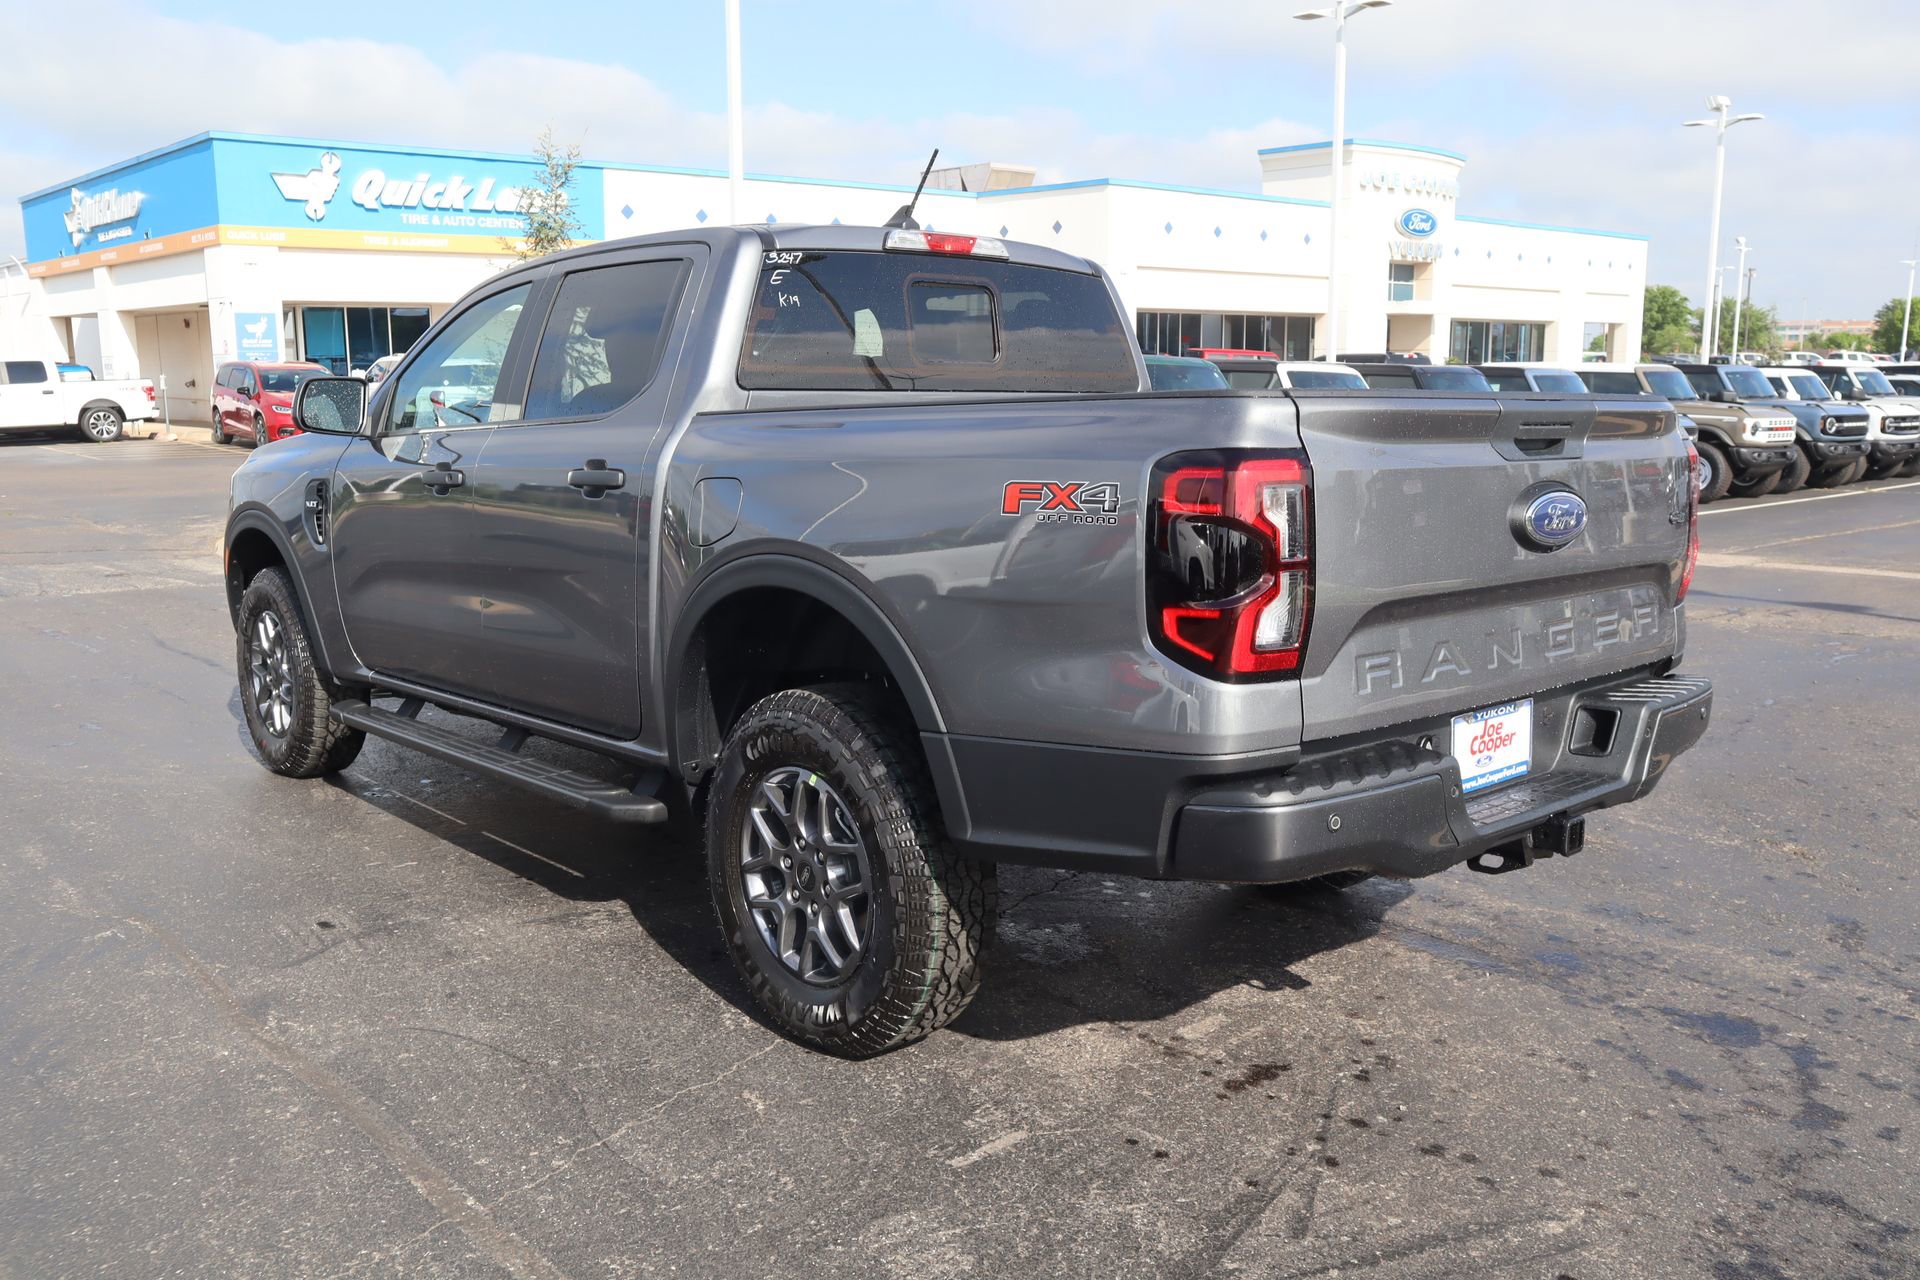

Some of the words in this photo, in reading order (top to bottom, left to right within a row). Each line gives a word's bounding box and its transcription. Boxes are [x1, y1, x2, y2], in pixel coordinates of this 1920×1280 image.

[351, 169, 474, 212] Quick
[400, 213, 430, 225] TIRE
[432, 215, 441, 225] &
[443, 216, 476, 227] AUTO
[770, 269, 791, 285] E
[1001, 480, 1121, 516] FX4
[1036, 513, 1069, 524] OFF
[1073, 515, 1120, 526] ROAD
[1353, 602, 1660, 696] RANGER
[1476, 704, 1516, 721] YUKON
[1479, 720, 1504, 740] Joe
[1470, 731, 1517, 756] Cooper
